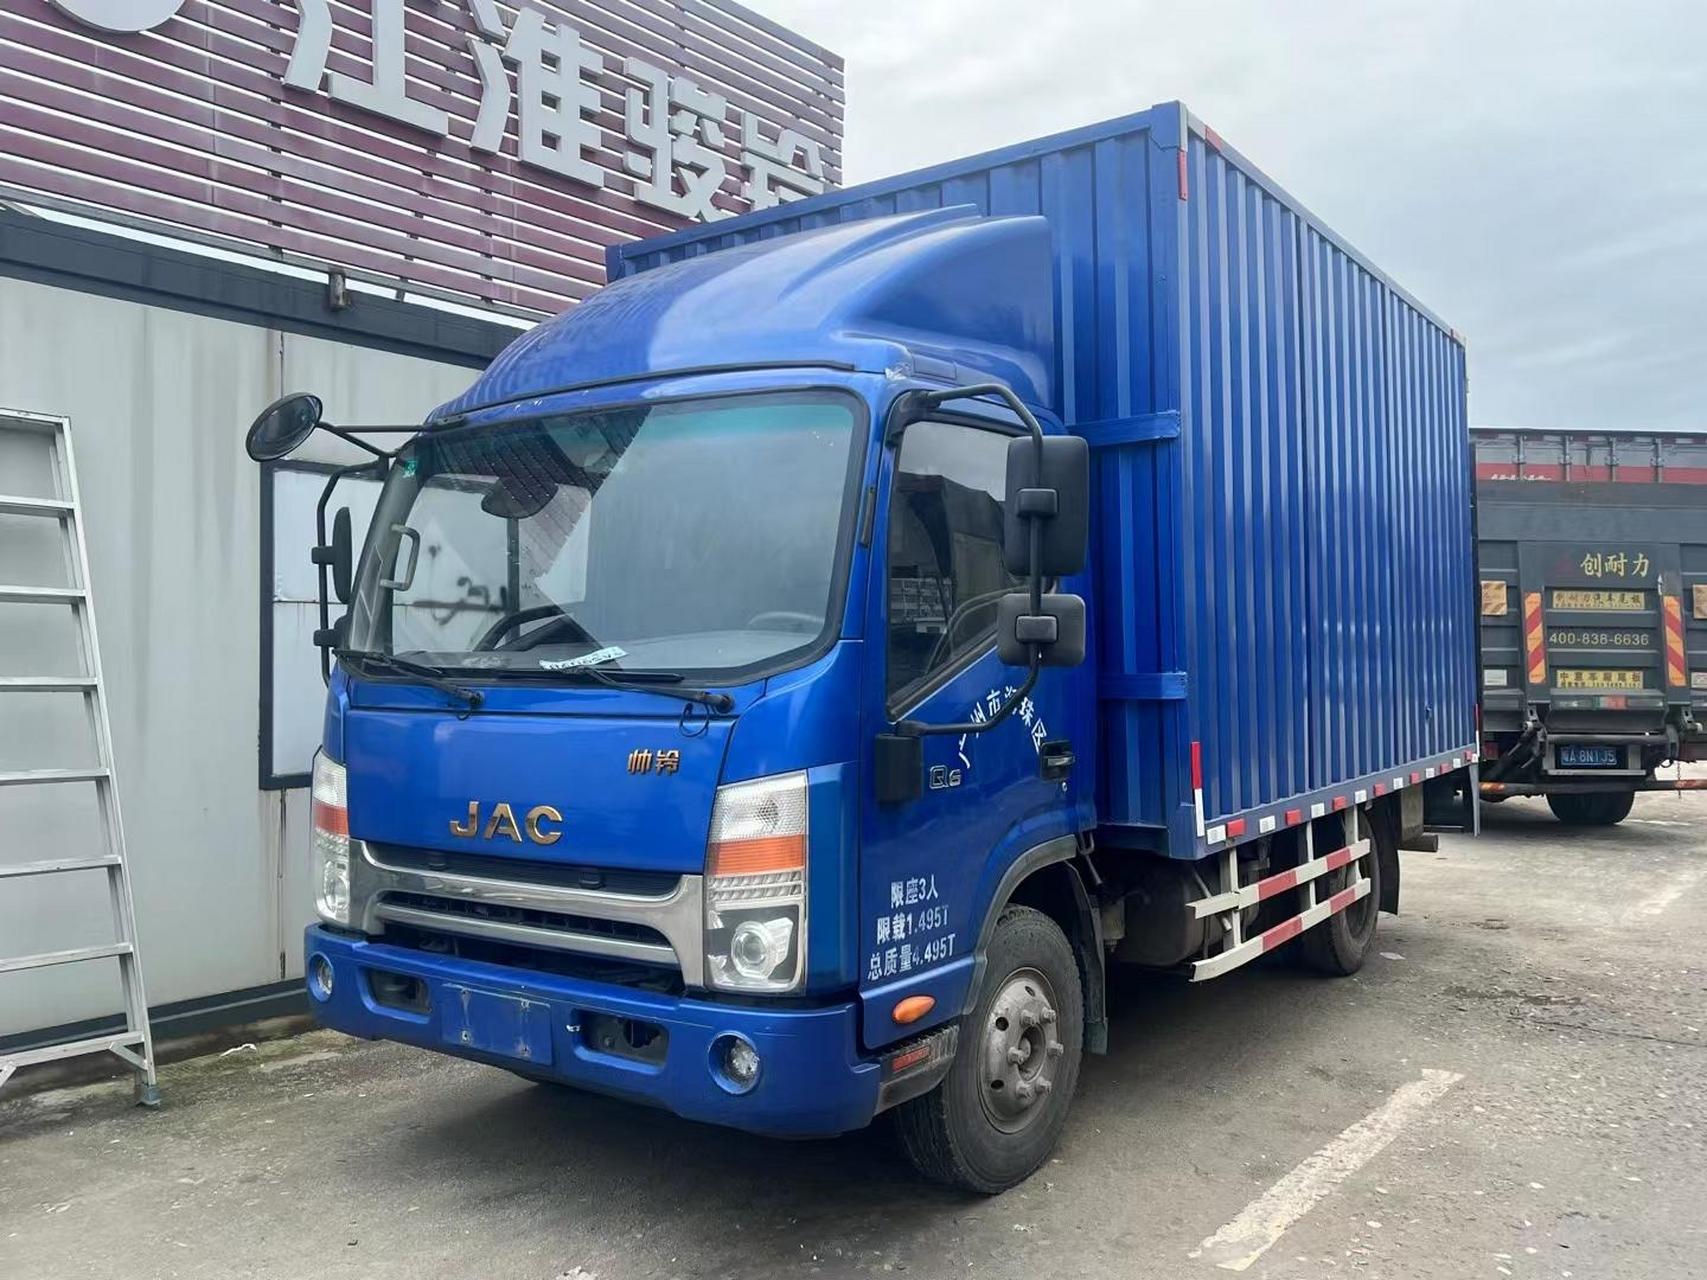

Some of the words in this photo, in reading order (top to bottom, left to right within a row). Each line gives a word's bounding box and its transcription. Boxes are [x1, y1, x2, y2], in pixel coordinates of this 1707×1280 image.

[1580, 552, 1649, 577] 创耐力
[1549, 632, 1649, 646] 400-838-6636
[627, 748, 680, 775] 帅铃
[449, 800, 563, 846] JAC
[890, 874, 938, 909] 限座3人
[877, 904, 949, 945] 限载1.495T
[868, 933, 956, 981] 总质量4.495T
